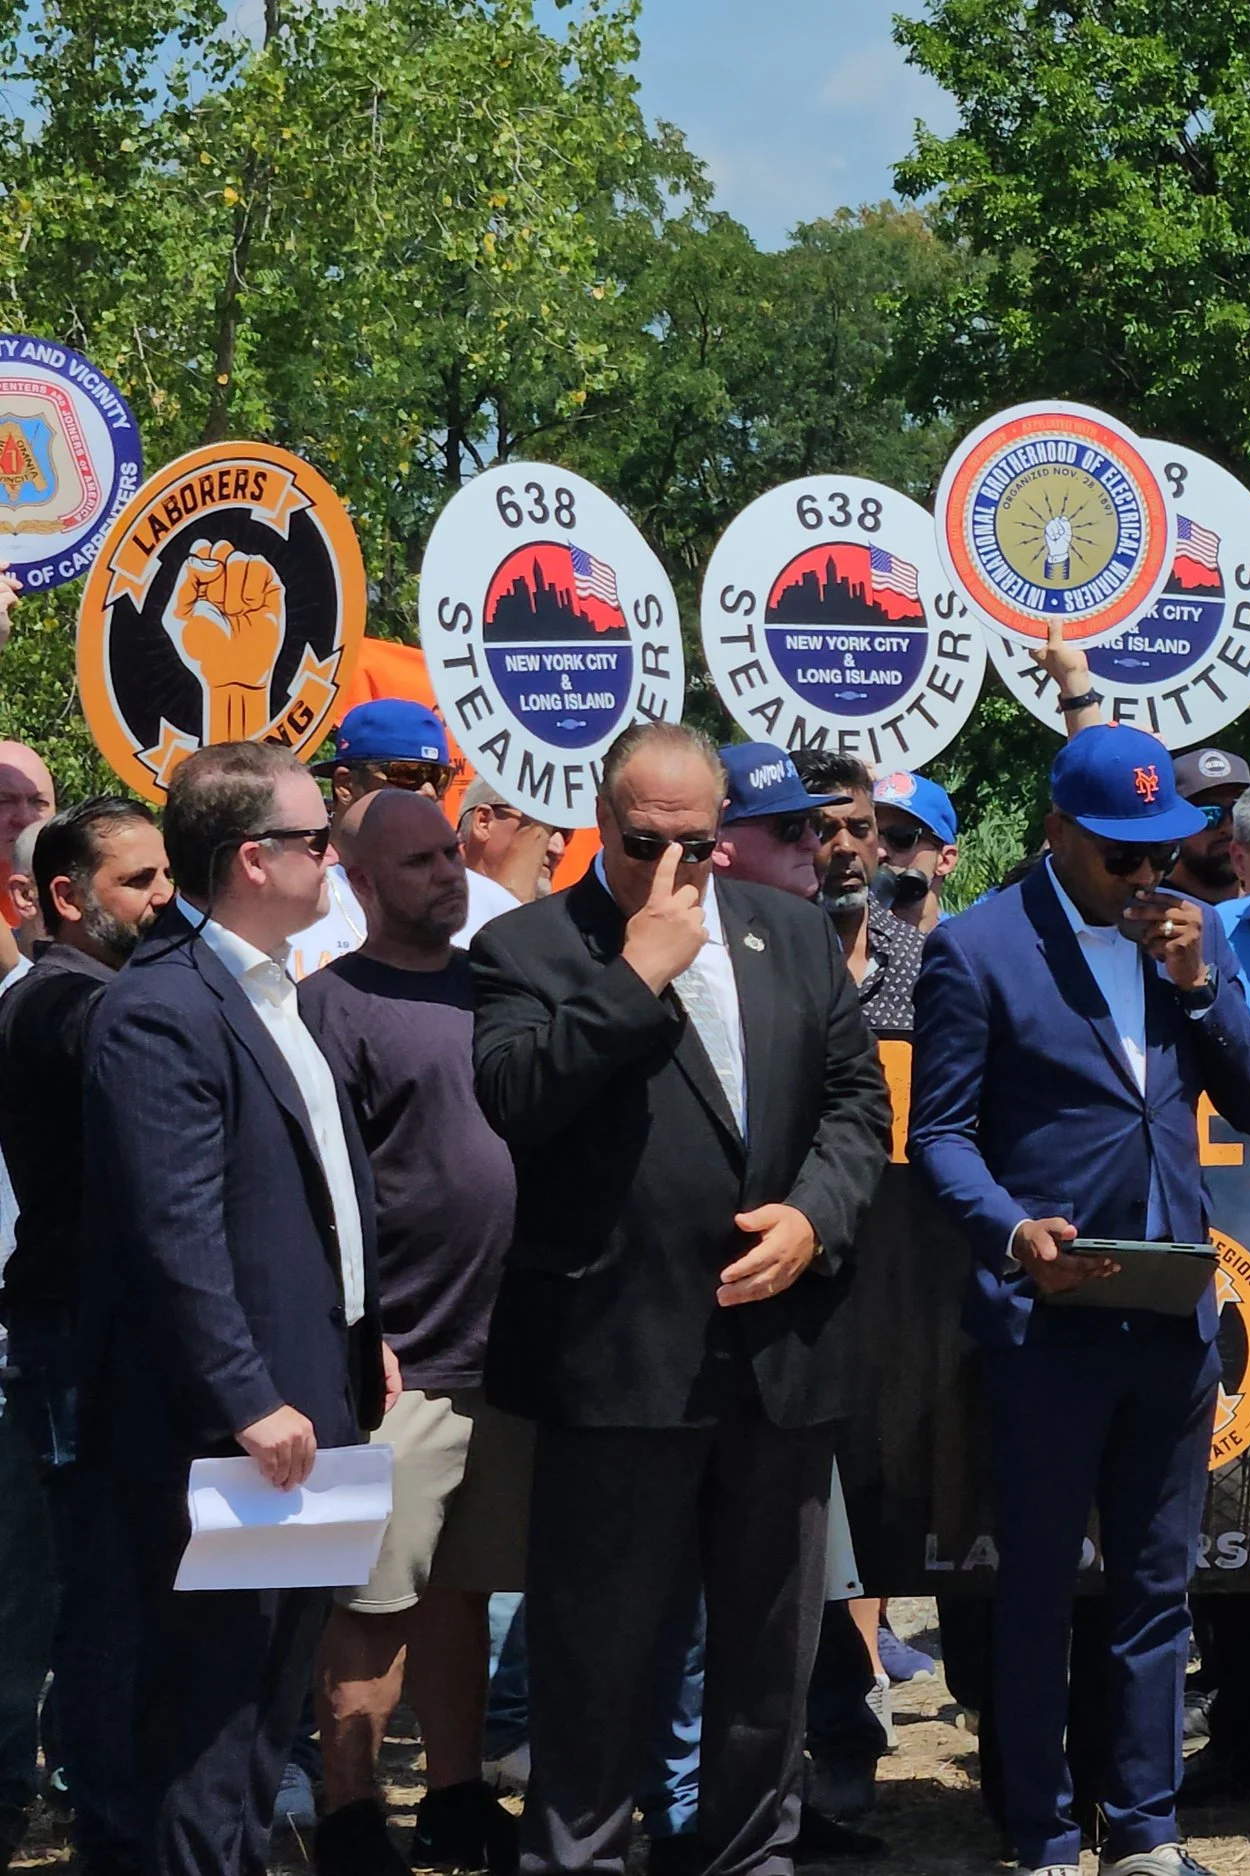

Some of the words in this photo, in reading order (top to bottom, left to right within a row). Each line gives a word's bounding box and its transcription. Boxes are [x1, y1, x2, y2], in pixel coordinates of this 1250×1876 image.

[20, 342, 66, 369] AND
[68, 359, 131, 430] VICINITY
[0, 382, 47, 395] ENTERS
[62, 409, 84, 460] JOINERS
[74, 475, 97, 522] AMERICA
[980, 441, 1077, 502] BROTHERHOOD
[1081, 449, 1105, 471] OF
[133, 469, 267, 556] LABORERS
[495, 481, 577, 530] 638
[796, 491, 884, 533] 638
[1003, 467, 1049, 511] ORGANIZED
[1053, 467, 1079, 481] NOV.
[1098, 493, 1114, 517] 1891
[1101, 466, 1141, 557] ELECTRICAL
[27, 565, 54, 586] OF
[974, 505, 1047, 610] INTERNATIONAL
[1064, 559, 1129, 612] WORKERS
[1162, 604, 1203, 622] CITY
[505, 653, 542, 673] NEW
[543, 653, 584, 671] YORK
[586, 653, 618, 670] CITY
[786, 635, 823, 651] NEW
[825, 635, 872, 652] YORK
[874, 637, 911, 653] CITY
[843, 652, 856, 668] &
[1098, 636, 1125, 650] NG
[1127, 636, 1191, 655] ISLAND
[560, 674, 573, 691] &
[719, 584, 973, 764] STEAMFITTERS
[797, 668, 843, 684] LONG
[845, 668, 903, 686] ISLAND
[438, 592, 672, 810] STEAMFIERS
[520, 694, 561, 712] LONG
[564, 693, 616, 710] ISLAND
[1209, 1430, 1243, 1461] ATE
